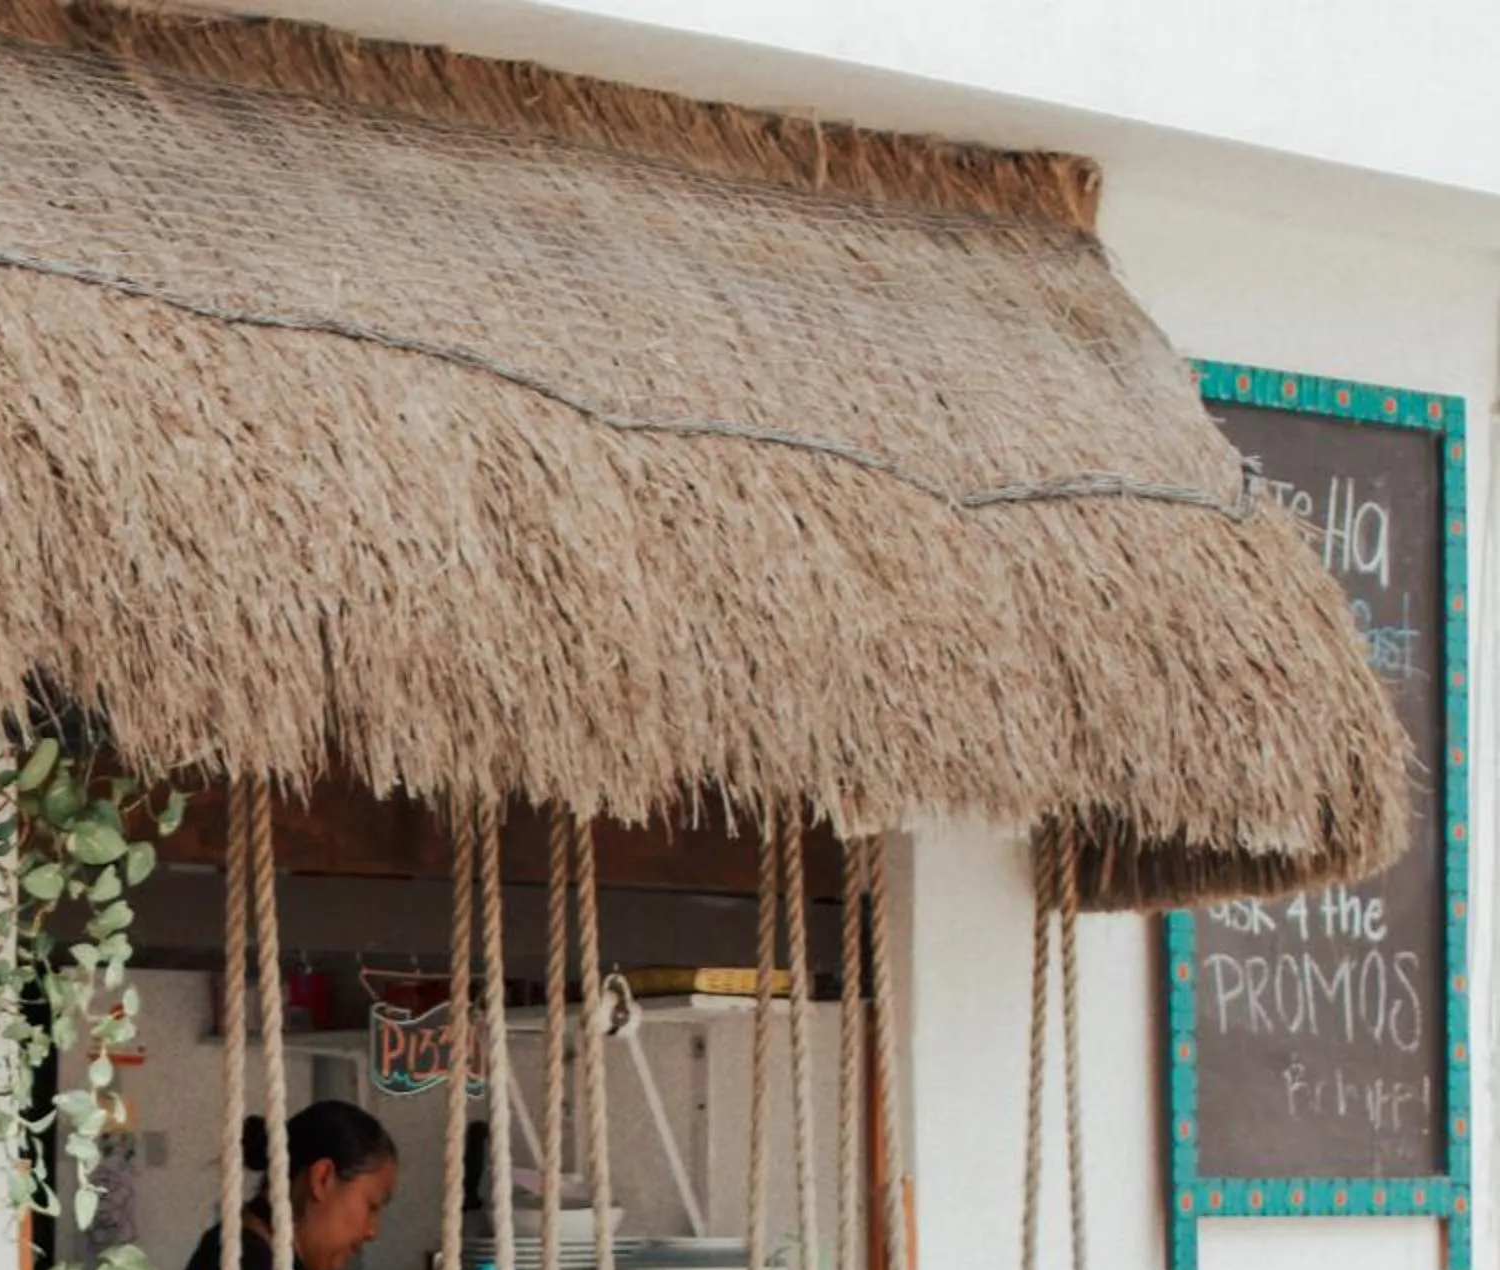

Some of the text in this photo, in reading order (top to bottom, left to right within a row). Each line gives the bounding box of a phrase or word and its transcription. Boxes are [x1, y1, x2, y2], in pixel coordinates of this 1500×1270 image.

[1286, 889, 1309, 942] 4
[1319, 882, 1388, 942] the
[1203, 948, 1422, 1053] PROMOS
